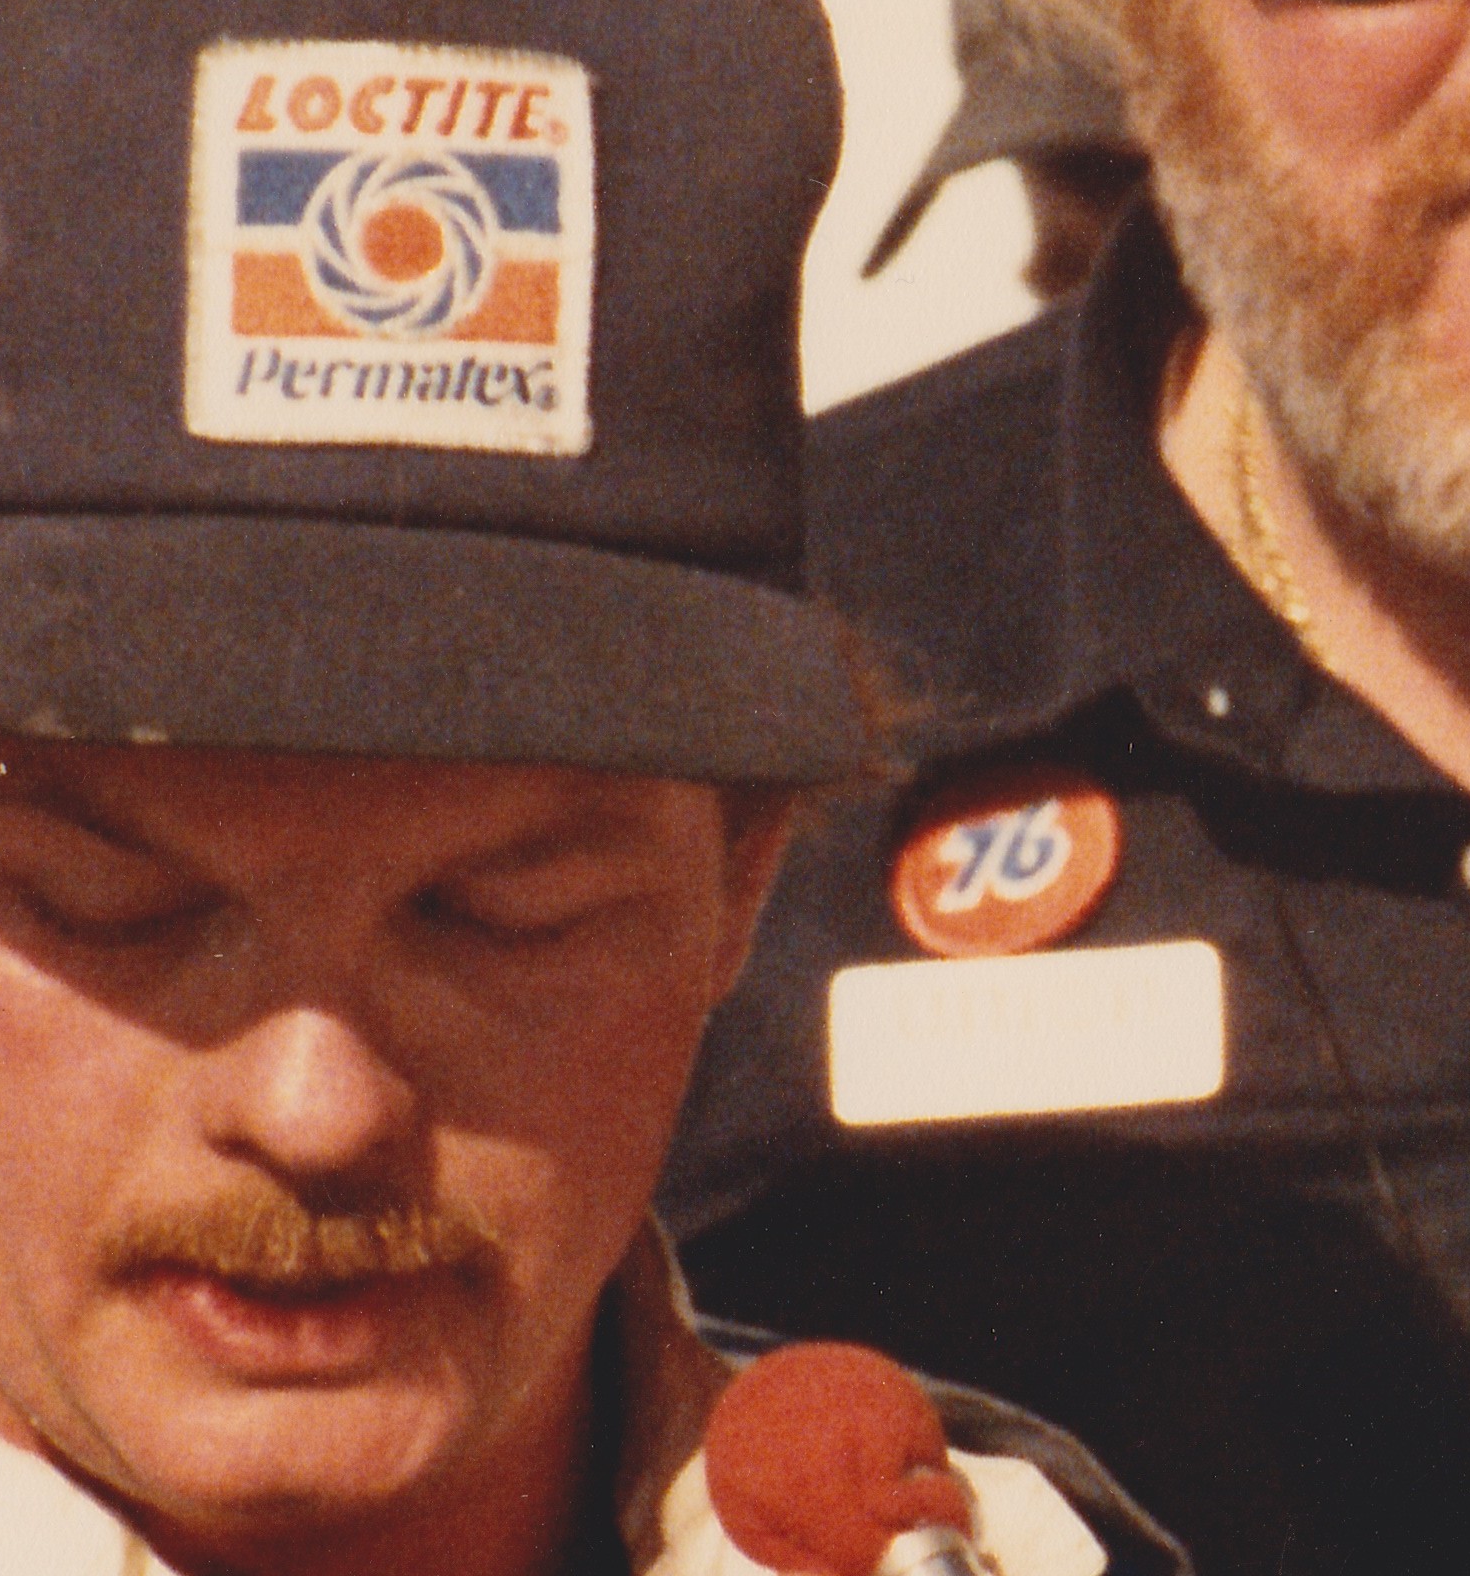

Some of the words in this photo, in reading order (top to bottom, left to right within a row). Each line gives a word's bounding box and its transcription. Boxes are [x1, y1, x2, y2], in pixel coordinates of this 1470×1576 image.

[235, 75, 551, 140] LOCTITE
[235, 347, 555, 407] Permatex
[946, 797, 1067, 904] 76
